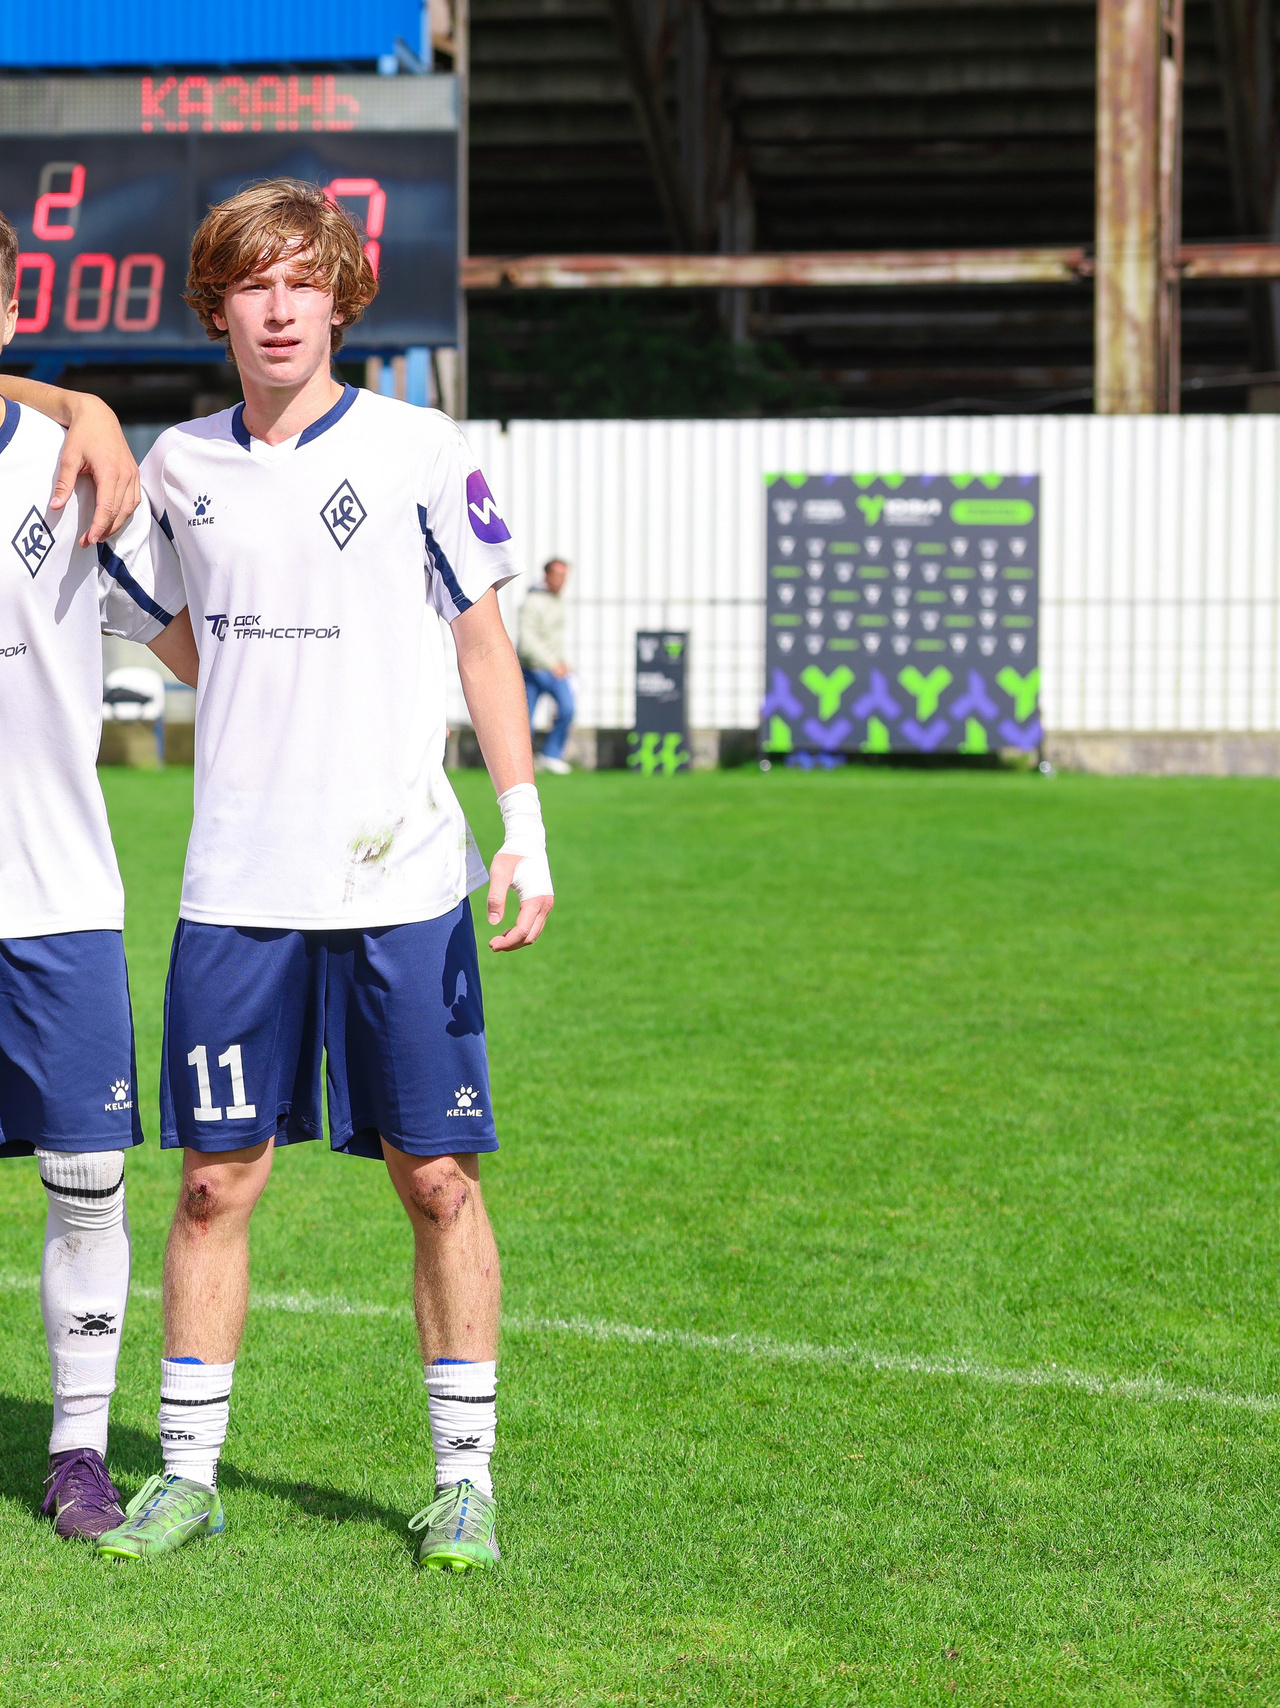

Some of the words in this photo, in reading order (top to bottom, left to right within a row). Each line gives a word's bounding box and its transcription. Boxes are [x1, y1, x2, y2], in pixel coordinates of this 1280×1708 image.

[141, 74, 360, 133] КАЗАНЬ
[32, 163, 86, 240] 2
[187, 517, 215, 527] KELME
[233, 615, 262, 626] ДСК
[233, 626, 341, 640] ТРАНССТРОЙ
[187, 1044, 257, 1122] 11
[104, 1101, 133, 1112] KELME
[446, 1108, 483, 1118] KELME
[69, 1327, 117, 1337] KELME
